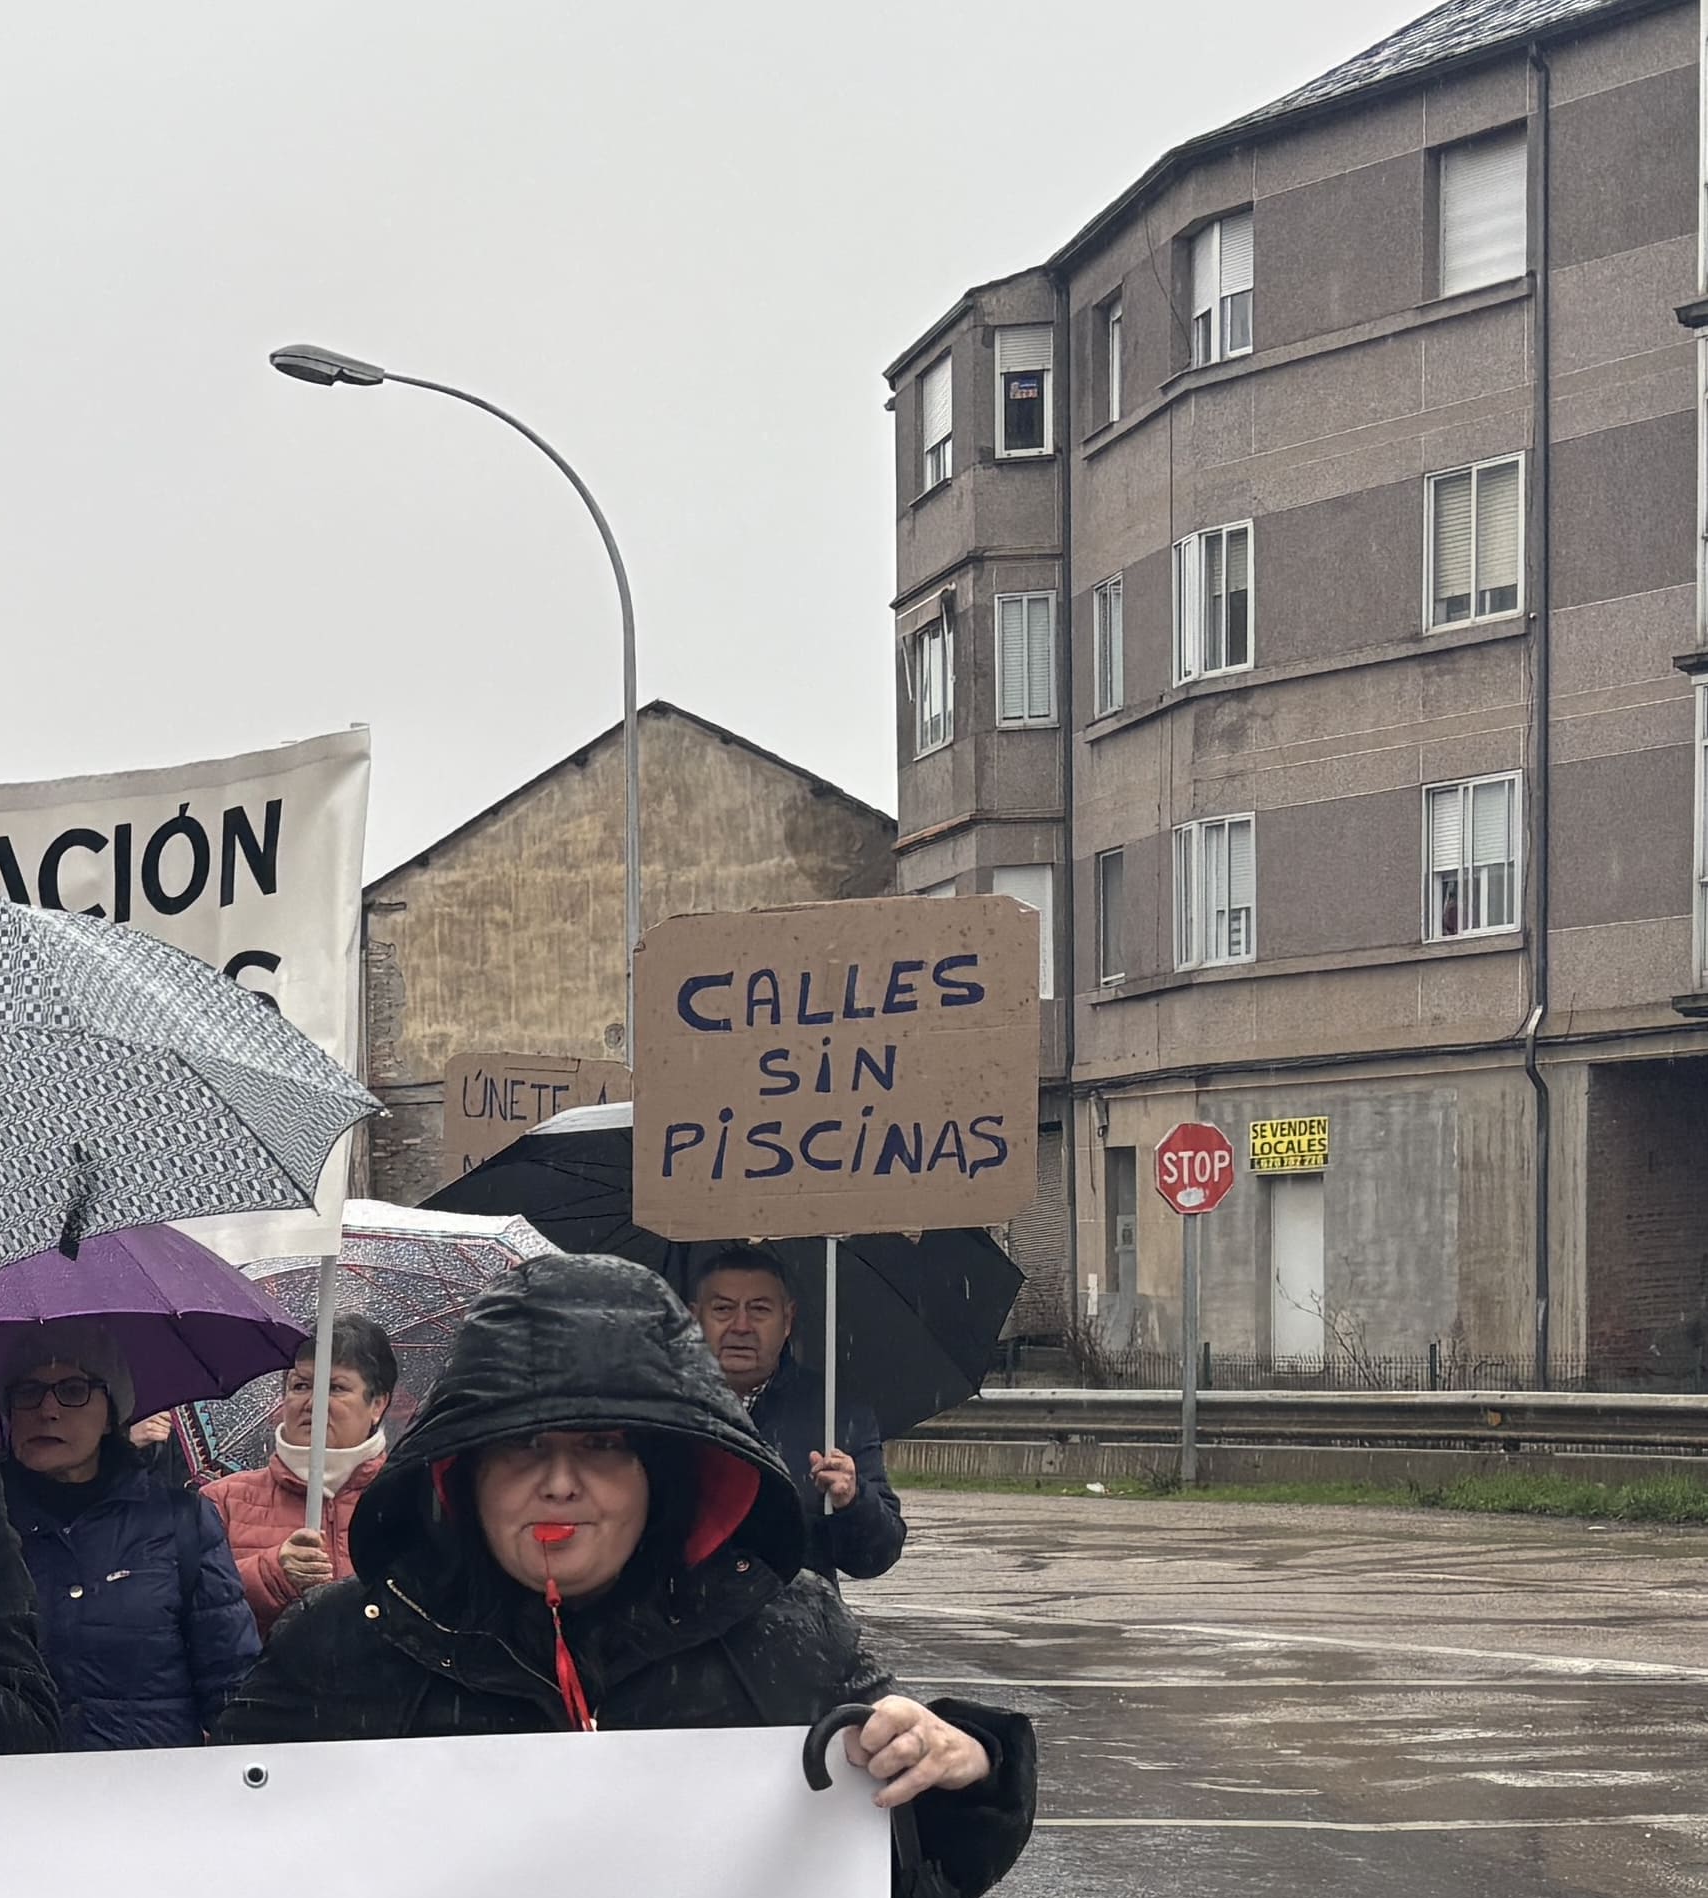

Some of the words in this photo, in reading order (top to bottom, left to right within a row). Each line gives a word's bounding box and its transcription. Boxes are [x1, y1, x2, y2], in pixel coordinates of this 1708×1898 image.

[676, 953, 986, 1032] CALLES
[1251, 1122, 1267, 1140] SE
[1269, 1119, 1327, 1138] VENDEN
[1251, 1137, 1327, 1157] LOCALES
[1163, 1150, 1230, 1184] STOP
